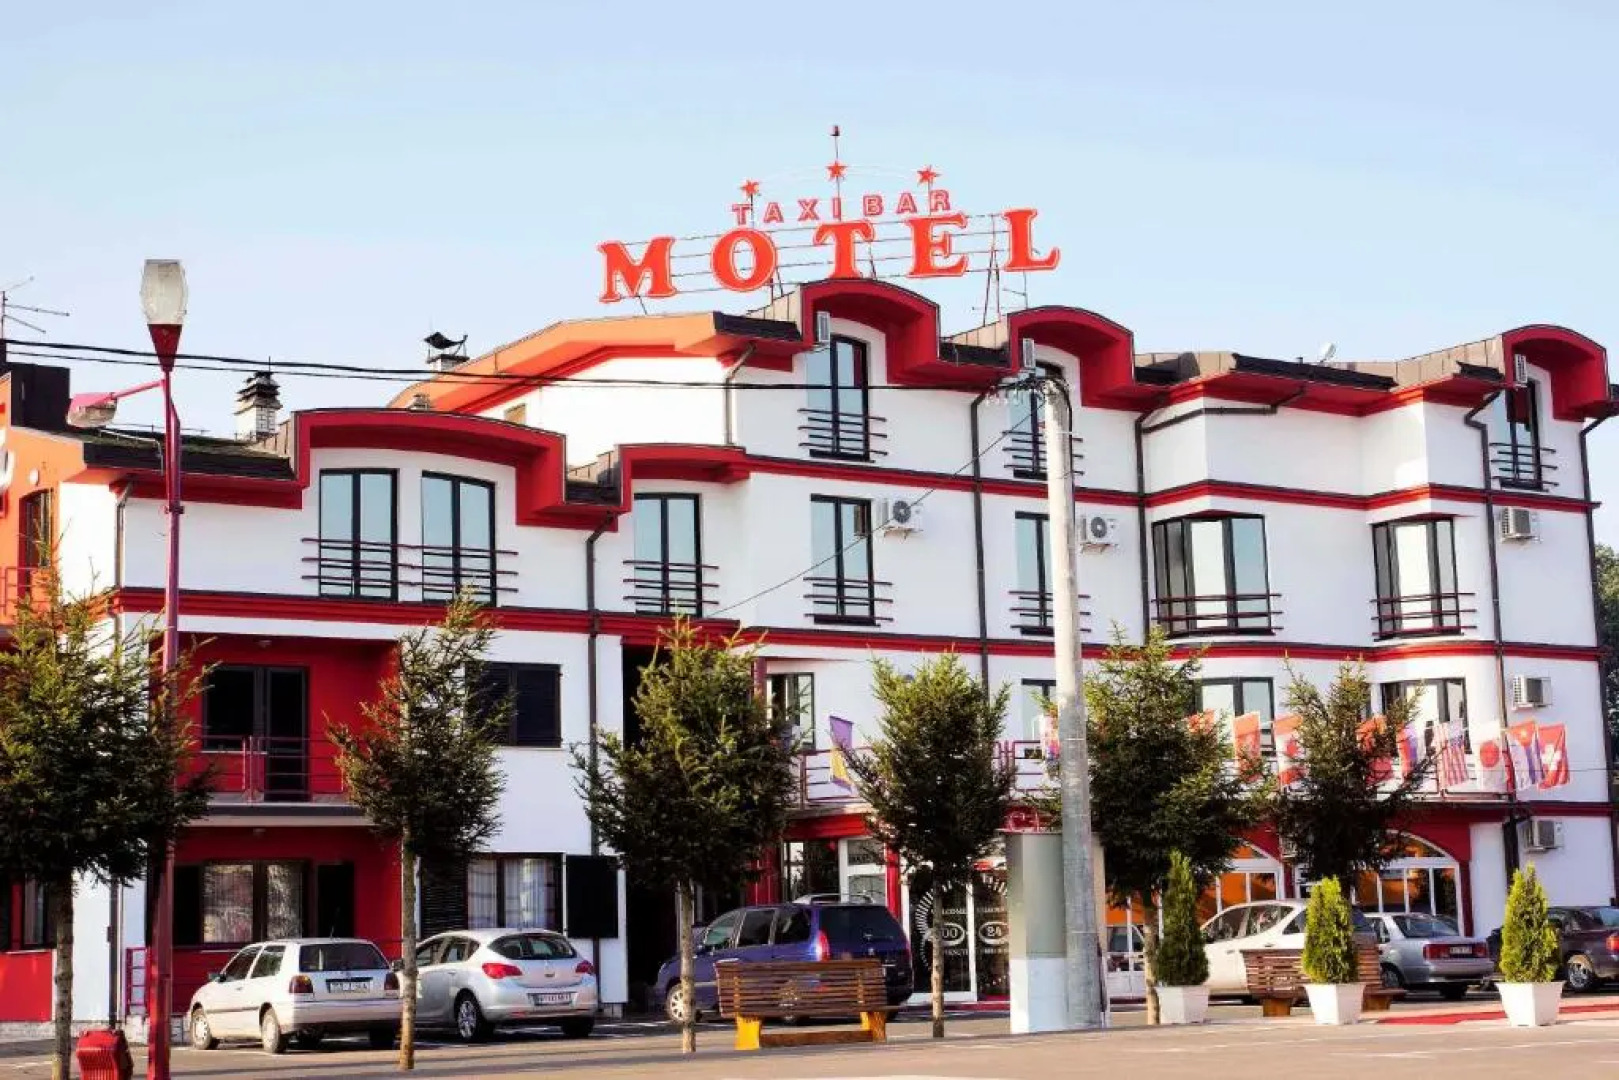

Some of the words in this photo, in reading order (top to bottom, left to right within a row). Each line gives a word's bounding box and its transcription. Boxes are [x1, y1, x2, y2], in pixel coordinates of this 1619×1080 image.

[732, 197, 842, 225] TAXI
[863, 189, 950, 216] BAR
[597, 208, 1060, 303] MOTEL
